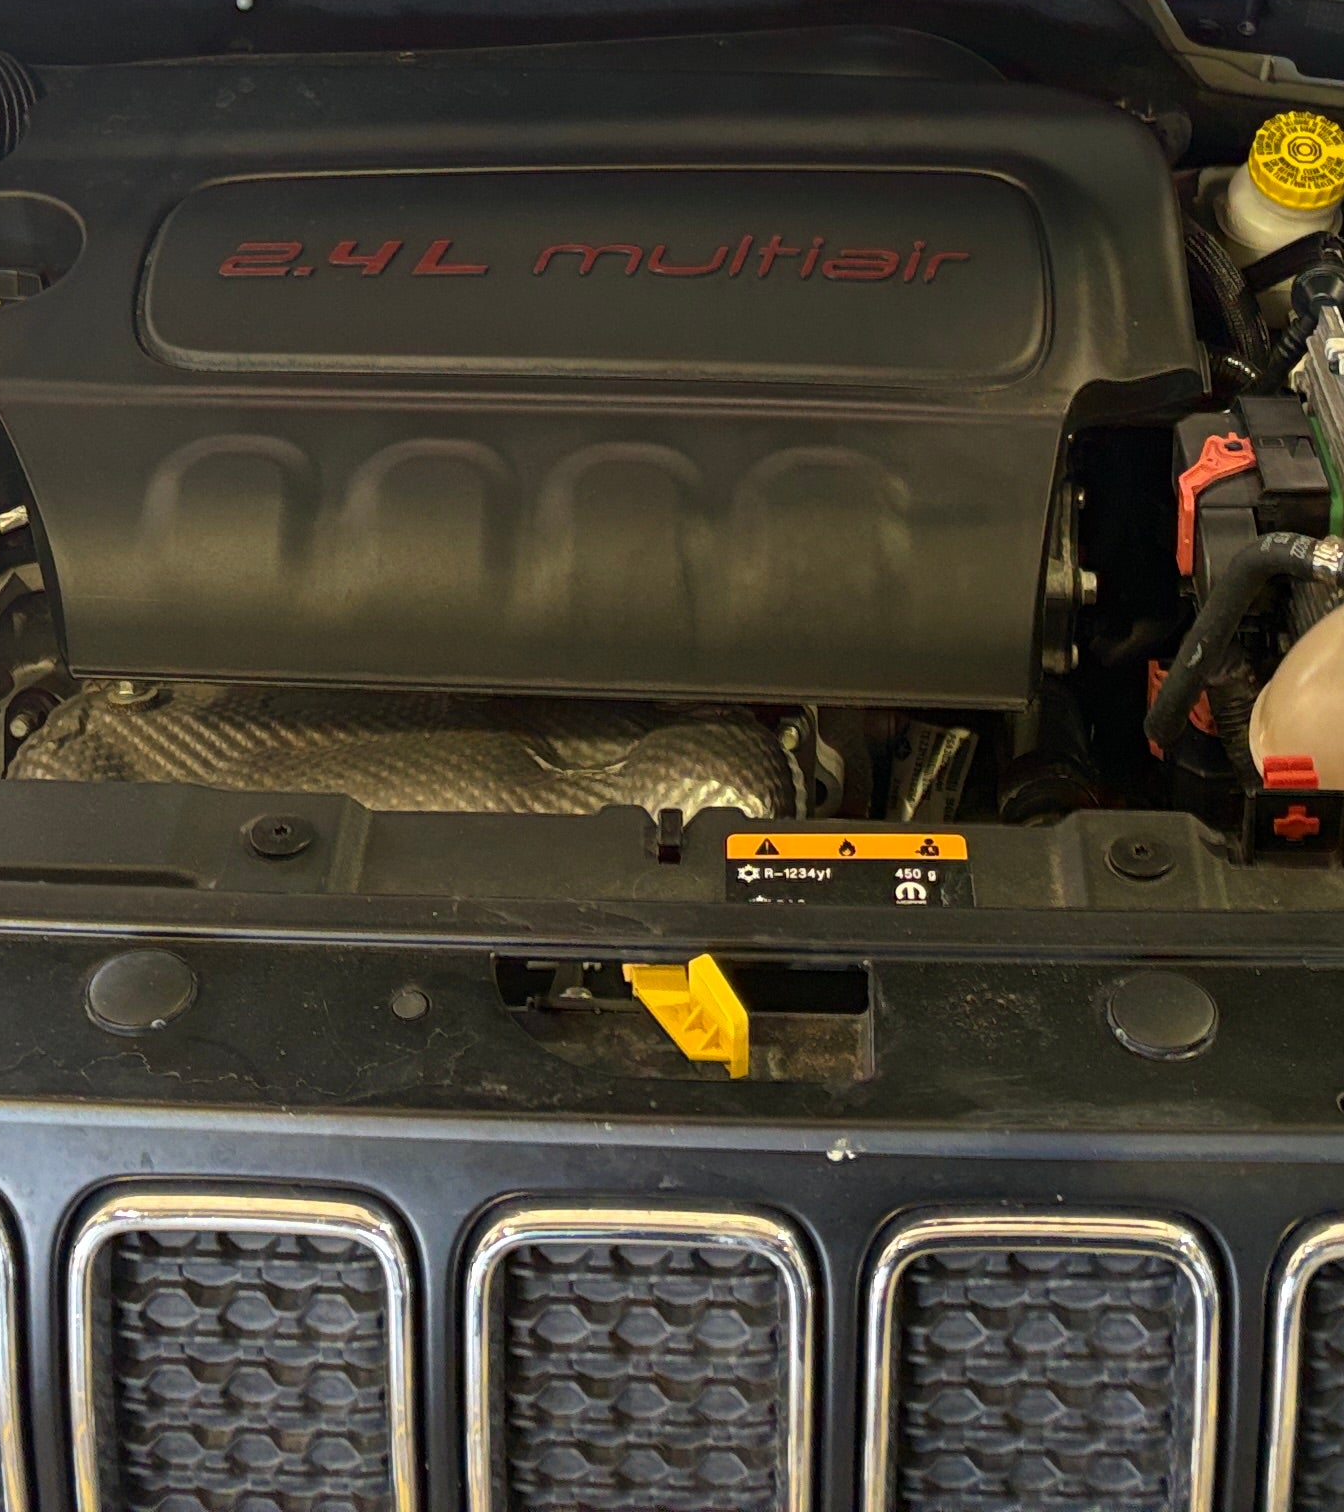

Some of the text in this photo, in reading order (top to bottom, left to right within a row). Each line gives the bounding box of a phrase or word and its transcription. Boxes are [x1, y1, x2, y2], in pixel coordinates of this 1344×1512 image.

[532, 234, 971, 285] multiair
[764, 867, 937, 882] R-1234yf 450 g
